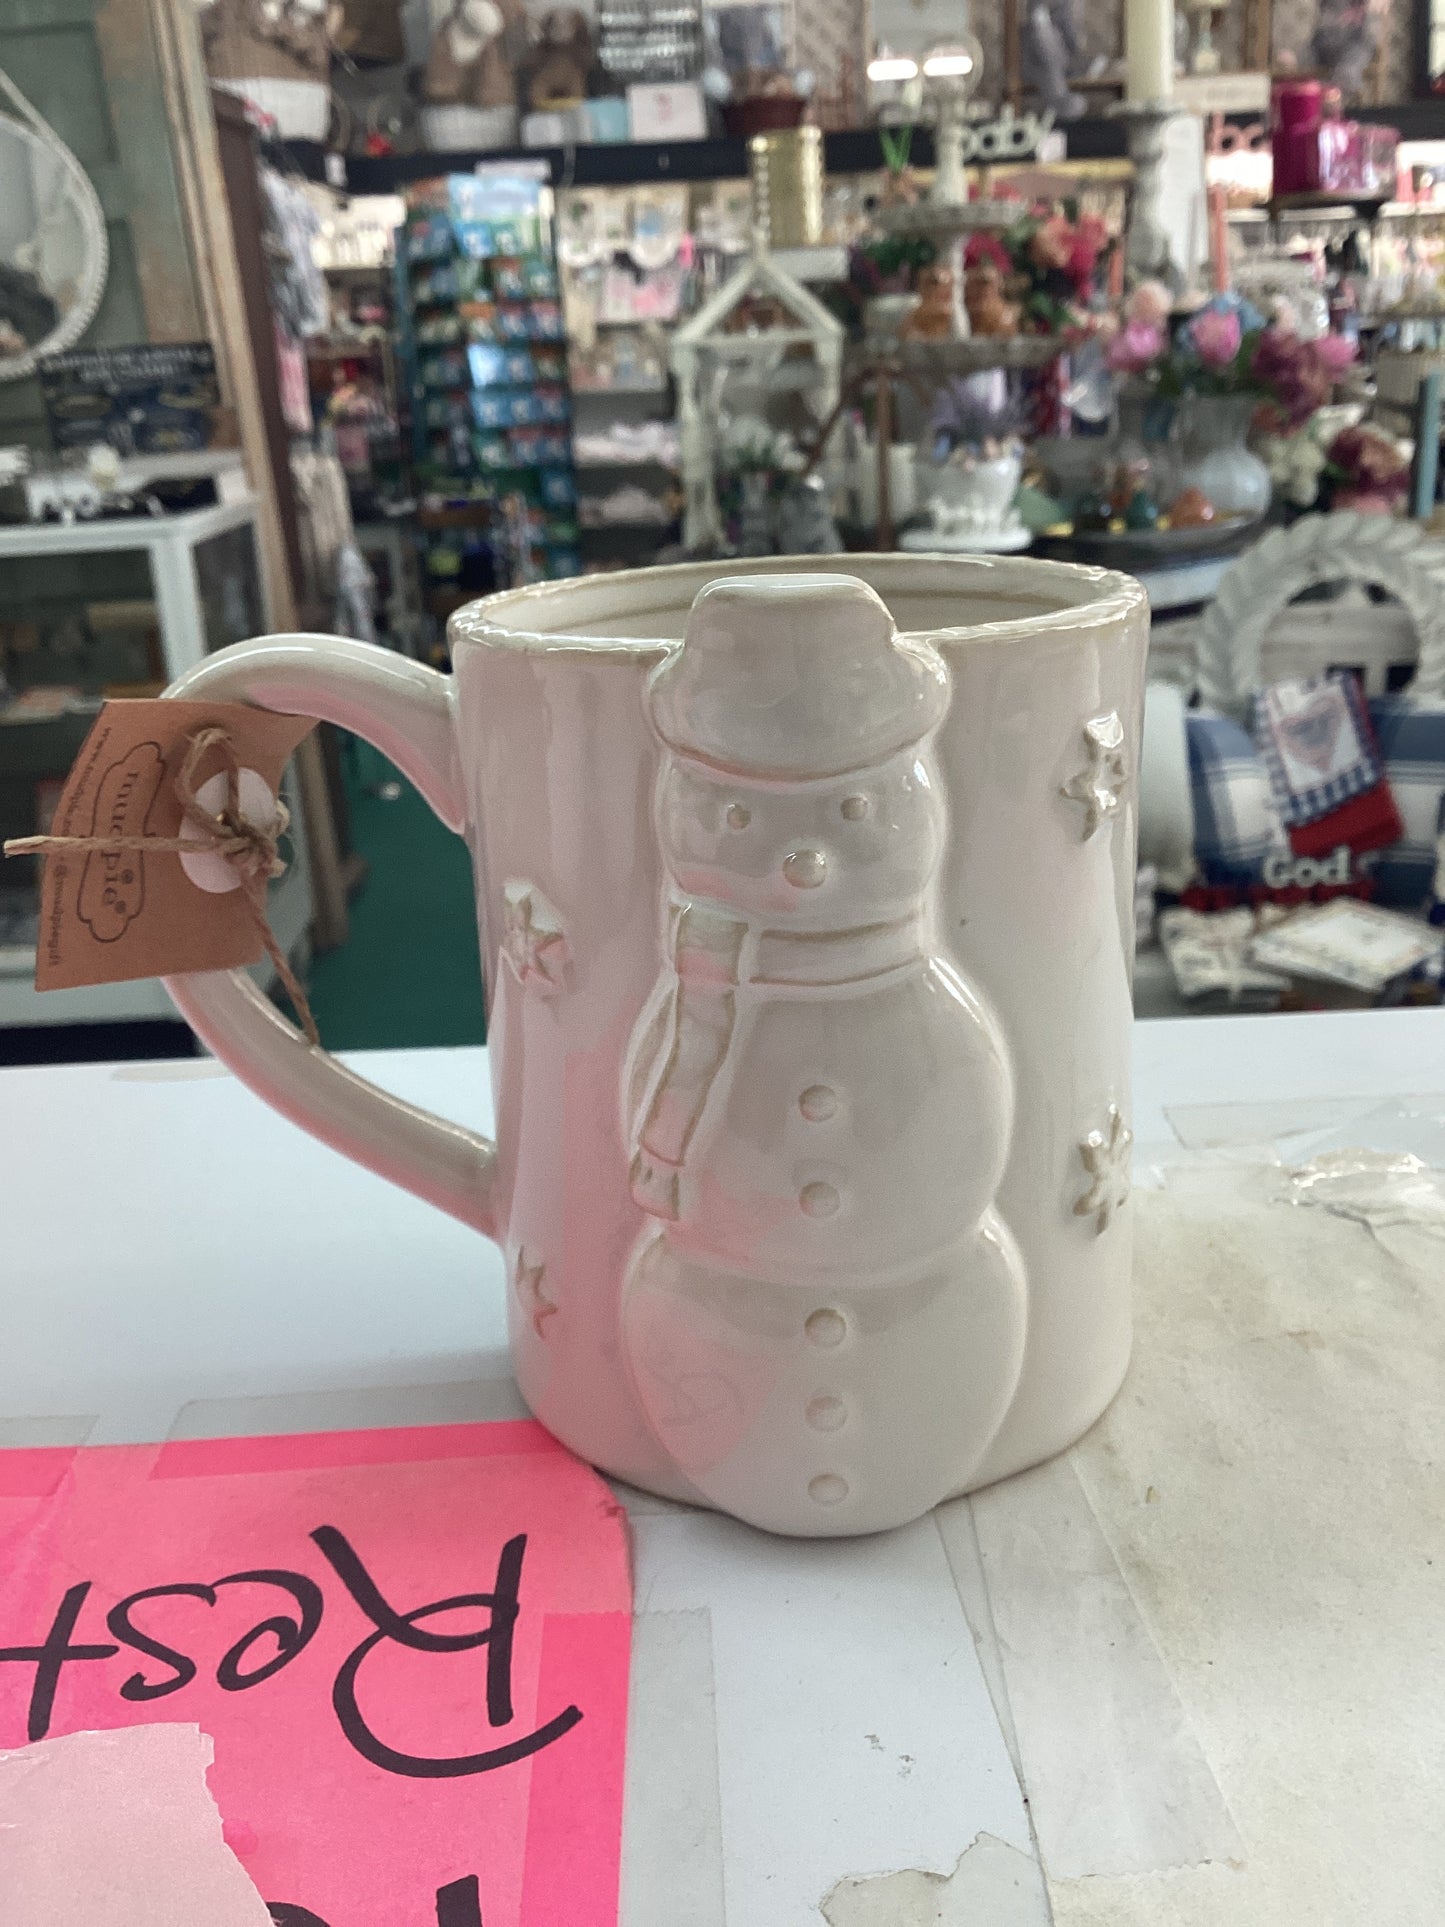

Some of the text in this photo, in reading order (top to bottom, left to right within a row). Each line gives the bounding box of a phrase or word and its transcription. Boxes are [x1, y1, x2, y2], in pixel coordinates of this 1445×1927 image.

[62, 727, 112, 837] www.mudpie.co
[1263, 845, 1350, 888] God
[0, 1524, 583, 1778] Rest
